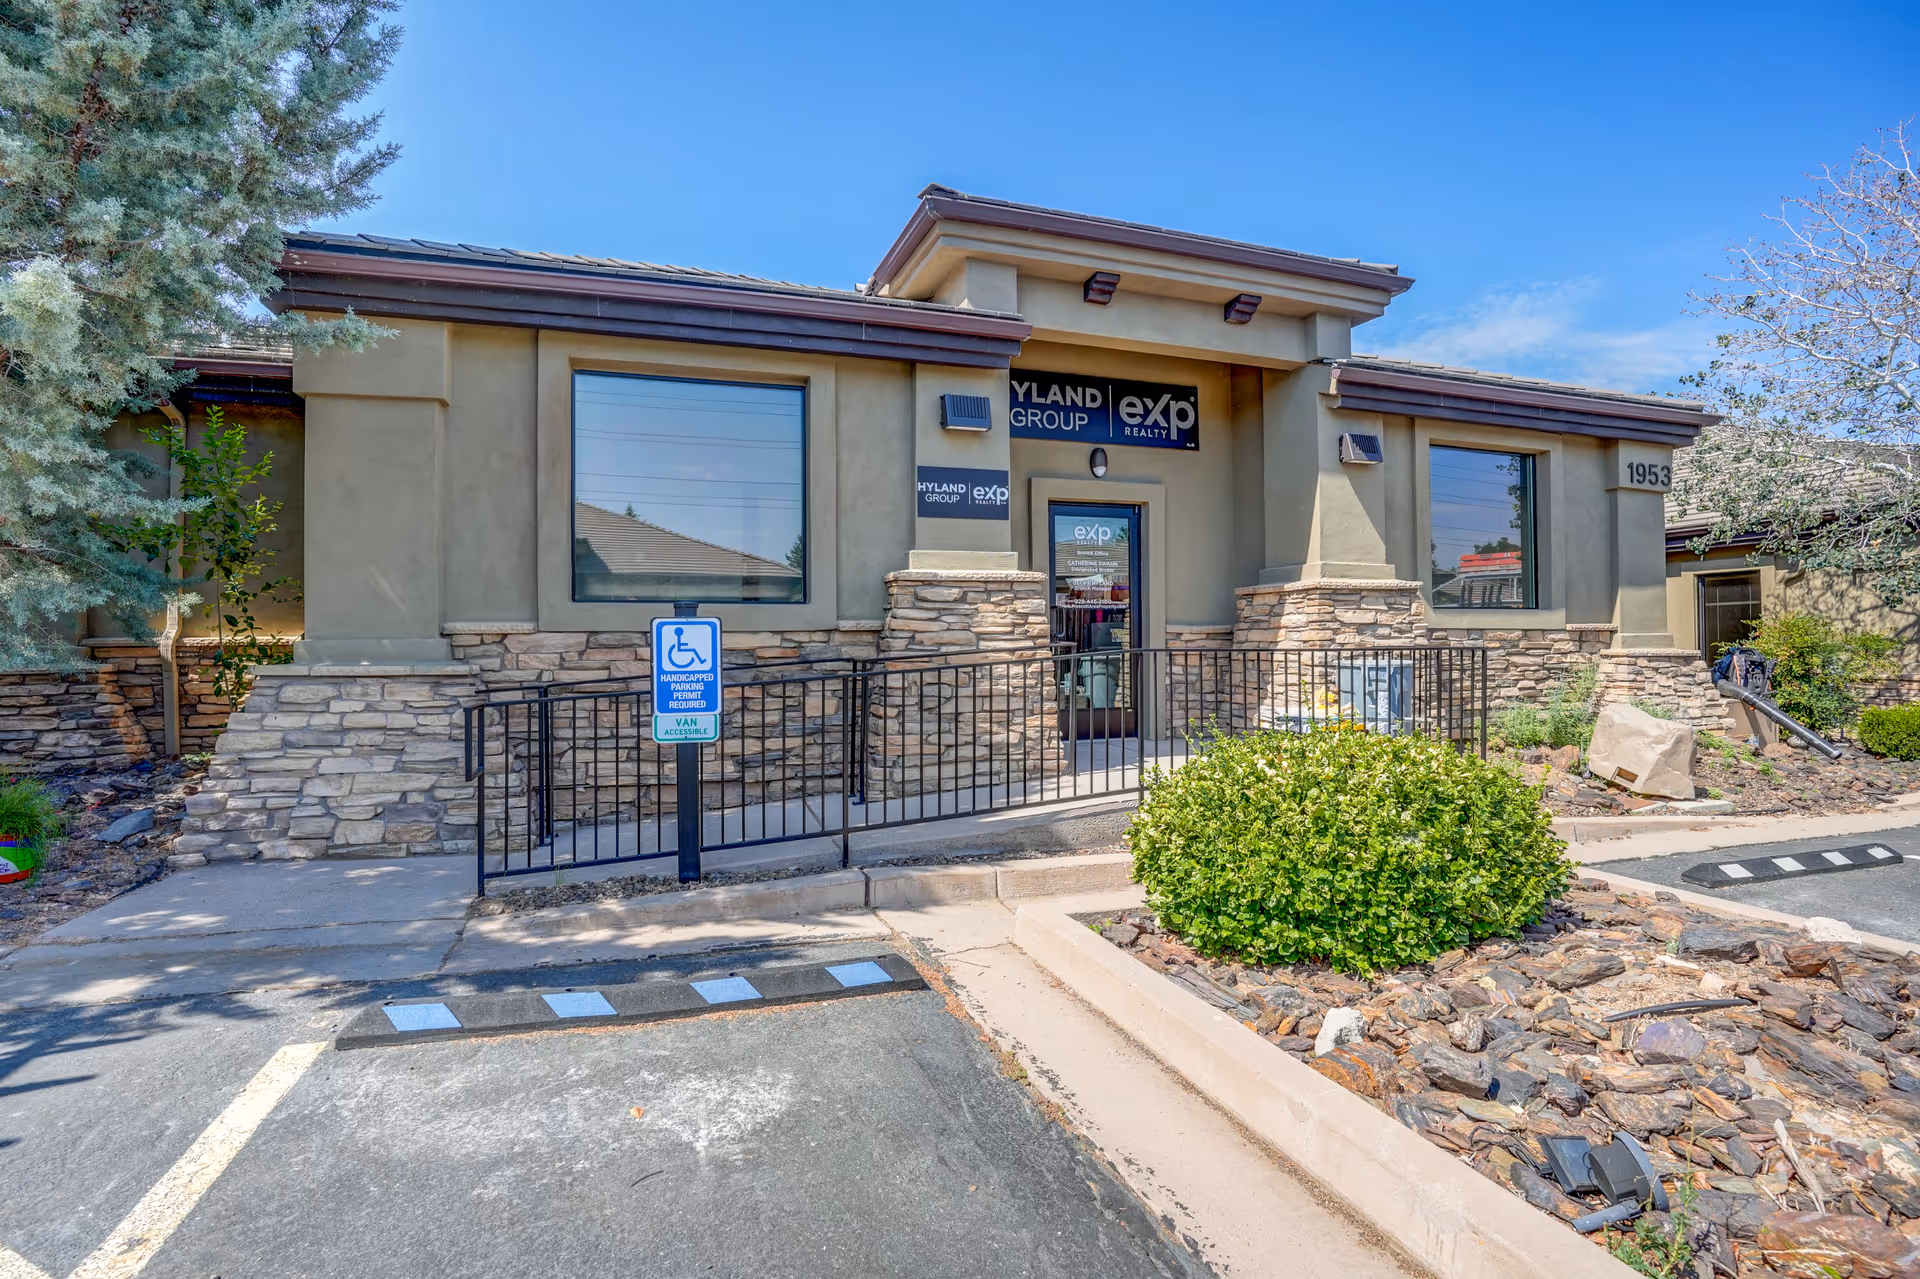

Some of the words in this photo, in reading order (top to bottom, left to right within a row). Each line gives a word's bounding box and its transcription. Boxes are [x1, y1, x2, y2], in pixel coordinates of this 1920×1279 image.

[1011, 380, 1102, 408] YLAND
[1010, 407, 1089, 431] GROUP
[1124, 426, 1167, 439] REALTY
[1627, 462, 1671, 487] 1953
[917, 482, 967, 493] HYLAND
[925, 493, 960, 503] GROUP
[660, 673, 714, 682] HANDICAPPED
[670, 683, 704, 691] PARKING
[673, 692, 702, 700] PERMIT
[669, 700, 707, 709] REQUIRED
[676, 717, 698, 727] VAN
[664, 728, 708, 736] ACCESSIBLE
